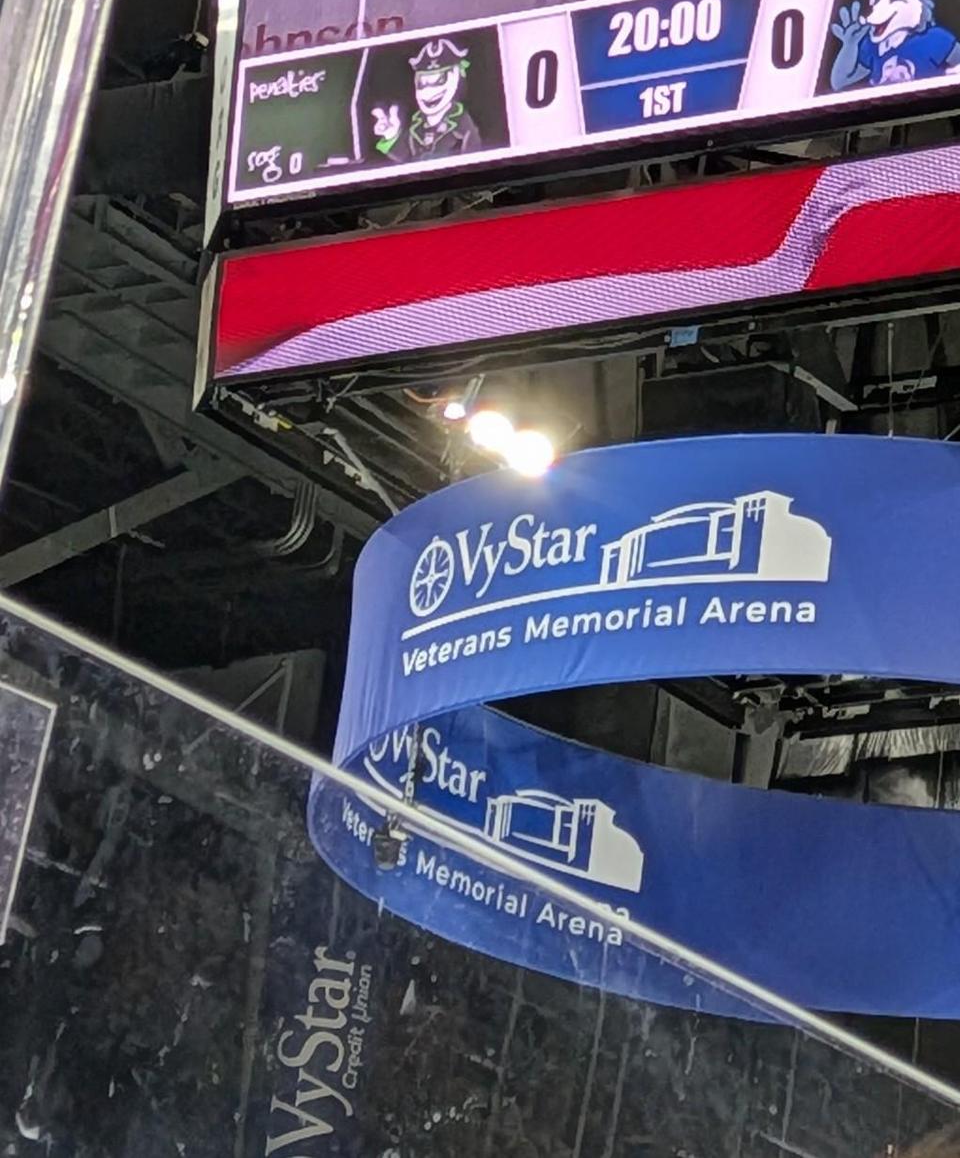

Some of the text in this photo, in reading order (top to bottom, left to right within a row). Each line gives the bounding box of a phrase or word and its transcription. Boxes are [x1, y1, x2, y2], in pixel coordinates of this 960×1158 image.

[525, 49, 559, 110] 0
[771, 8, 804, 70] 0
[639, 81, 687, 118] 1ST
[456, 513, 597, 599] VyStar
[401, 596, 817, 677] Veterans Memorial Arena
[341, 796, 624, 947] Veters Memorial Arena
[265, 945, 355, 1157] VyStar
[342, 963, 373, 1089] Credit Union
